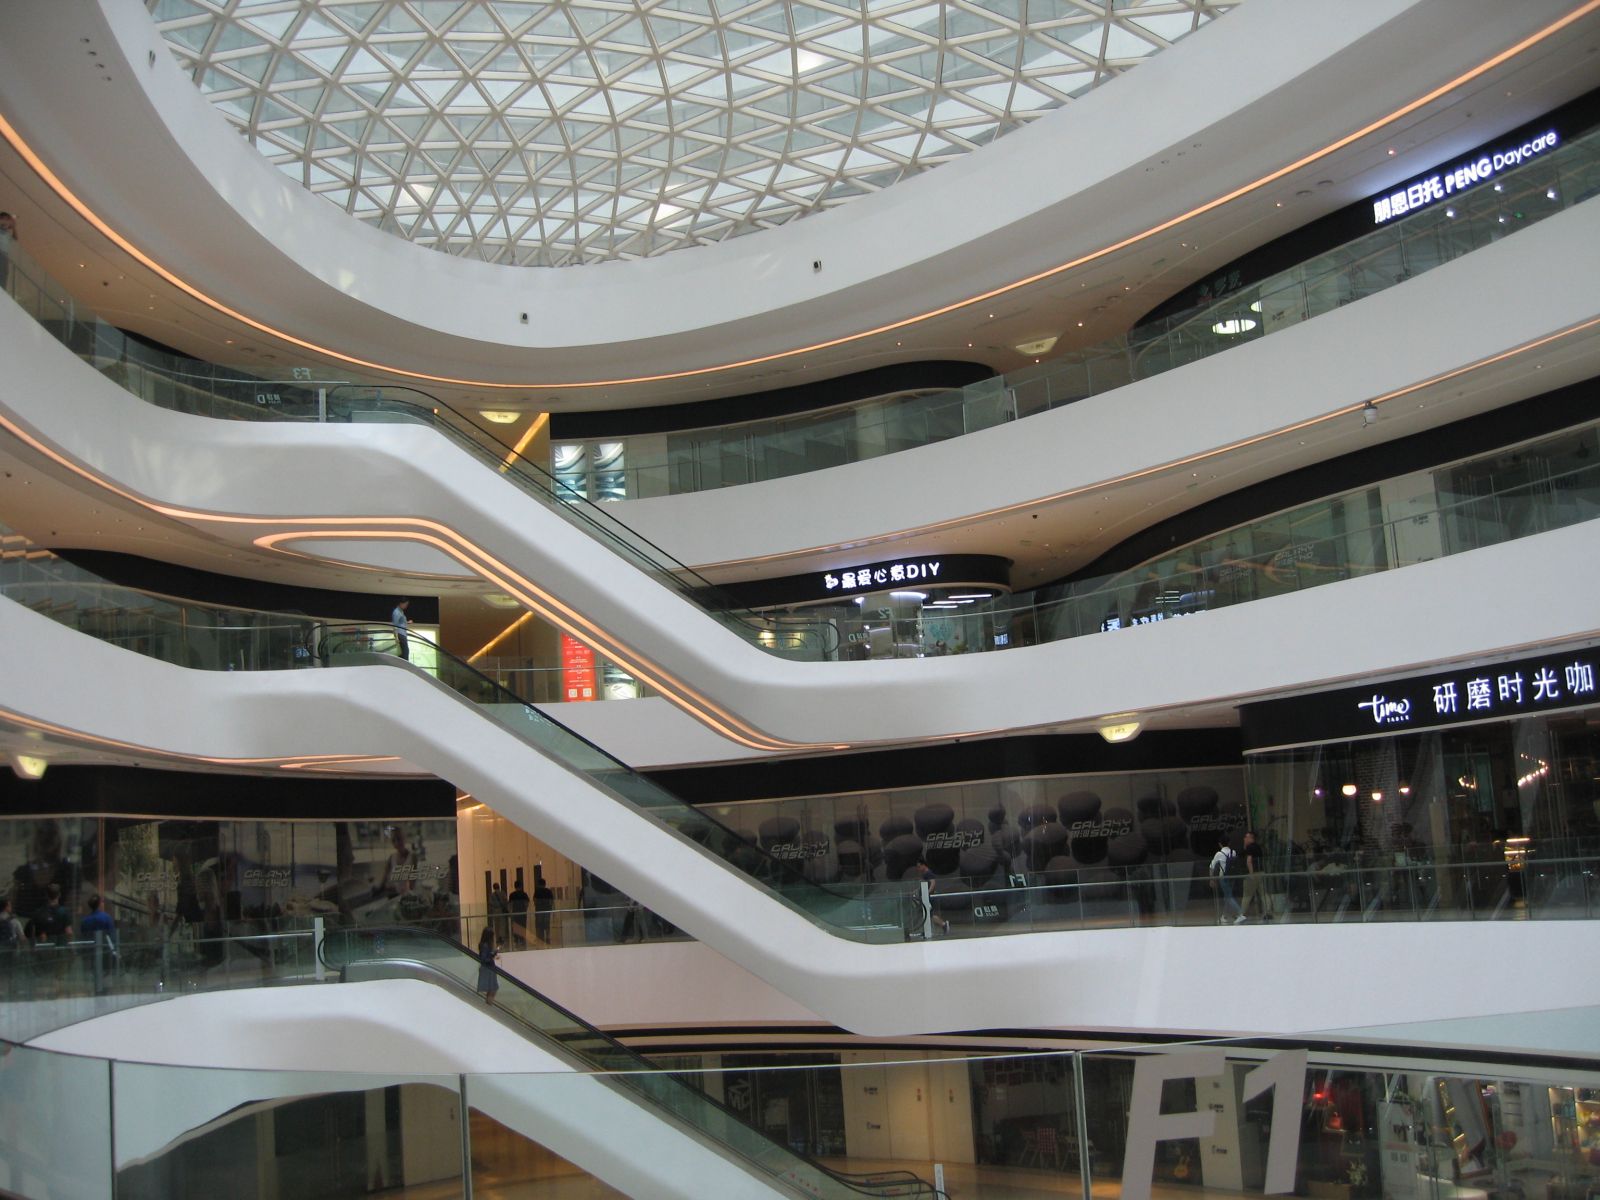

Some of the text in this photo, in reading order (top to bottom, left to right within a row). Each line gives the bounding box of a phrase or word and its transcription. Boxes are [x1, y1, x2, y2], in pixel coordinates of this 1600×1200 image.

[1444, 158, 1493, 194] PENG
[1493, 132, 1557, 170] Daycare
[1358, 661, 1594, 724] time 研磨时光咖
[926, 830, 983, 841] GALAXY
[1071, 818, 1132, 830] GALAXY
[1120, 1048, 1309, 1200] F1
